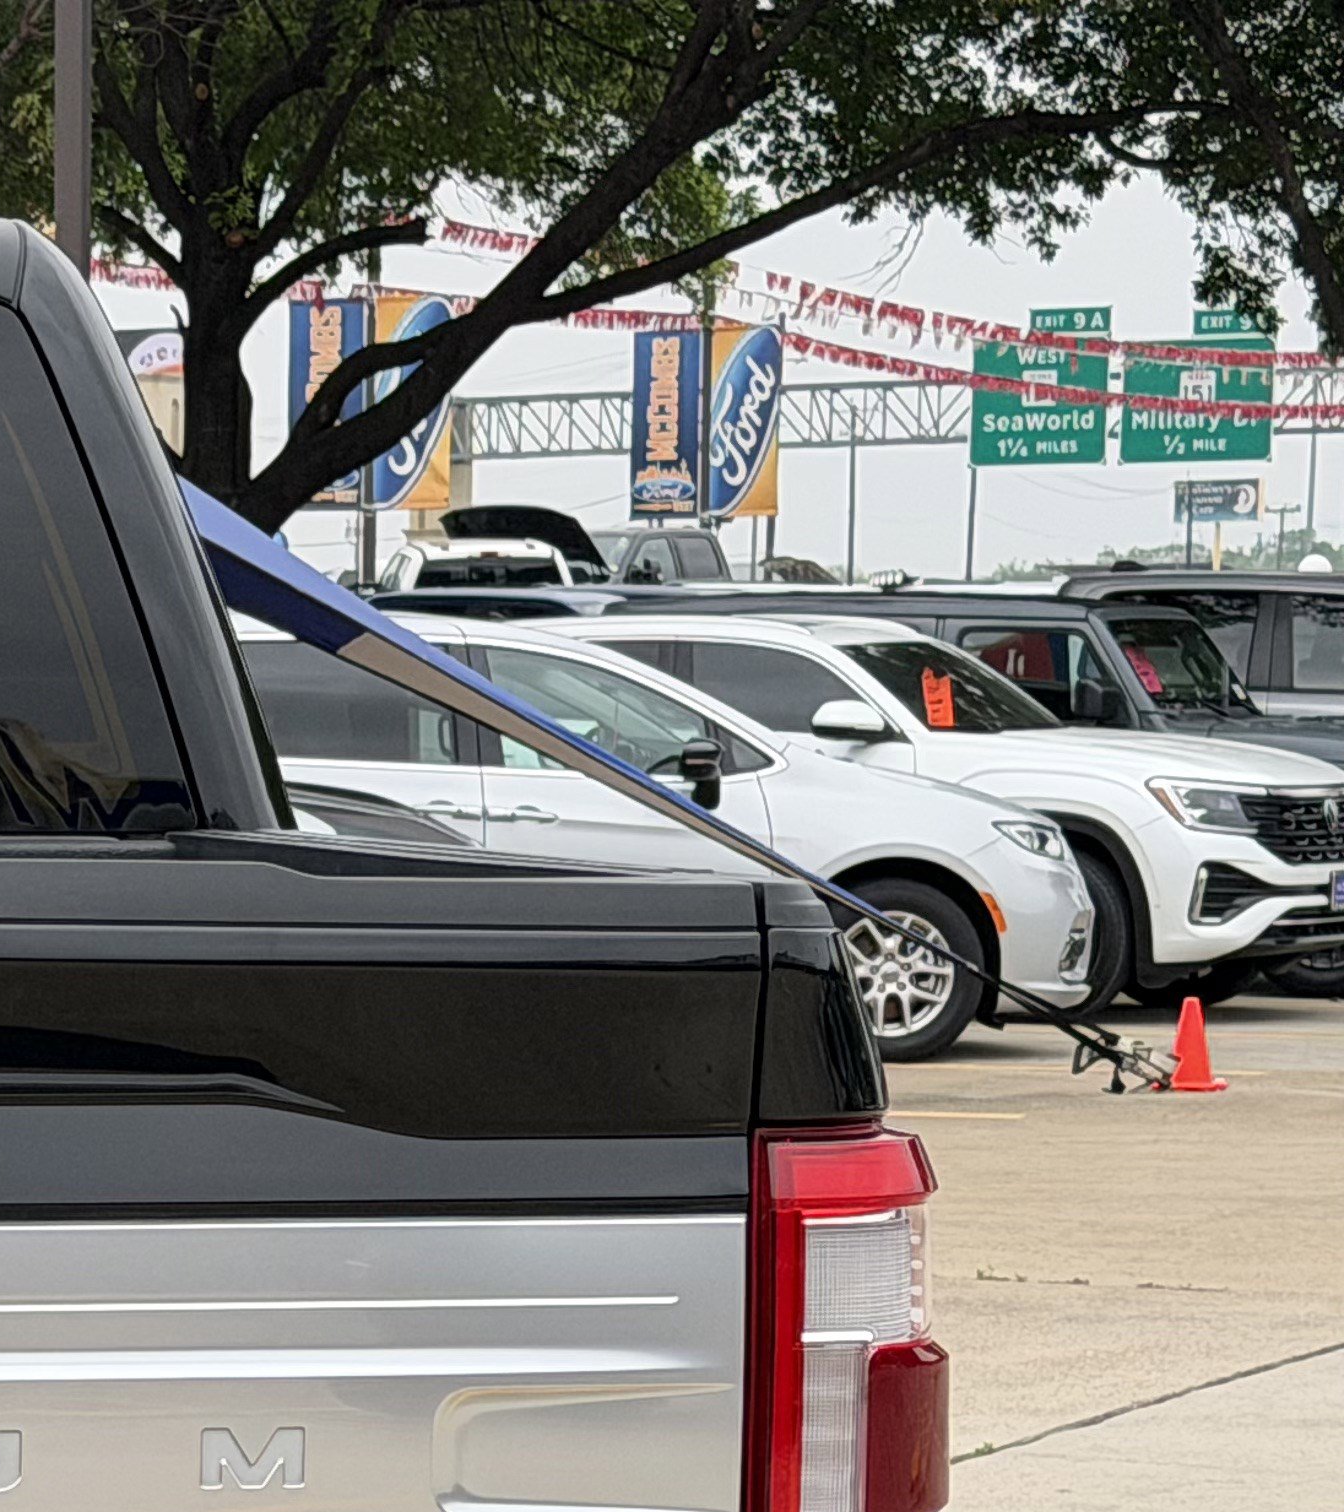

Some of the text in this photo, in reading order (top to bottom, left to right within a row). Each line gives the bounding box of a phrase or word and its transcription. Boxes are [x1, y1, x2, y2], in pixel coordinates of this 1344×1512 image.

[1036, 315, 1067, 328] EXIT
[1201, 315, 1233, 329] EXIT
[1015, 346, 1067, 365] WEST
[1183, 385, 1212, 401] 151
[709, 355, 776, 487] Ford
[982, 409, 1095, 432] SeaWorld
[1131, 408, 1222, 433] Military
[1036, 440, 1079, 454] MILES
[1192, 438, 1227, 452] MILE
